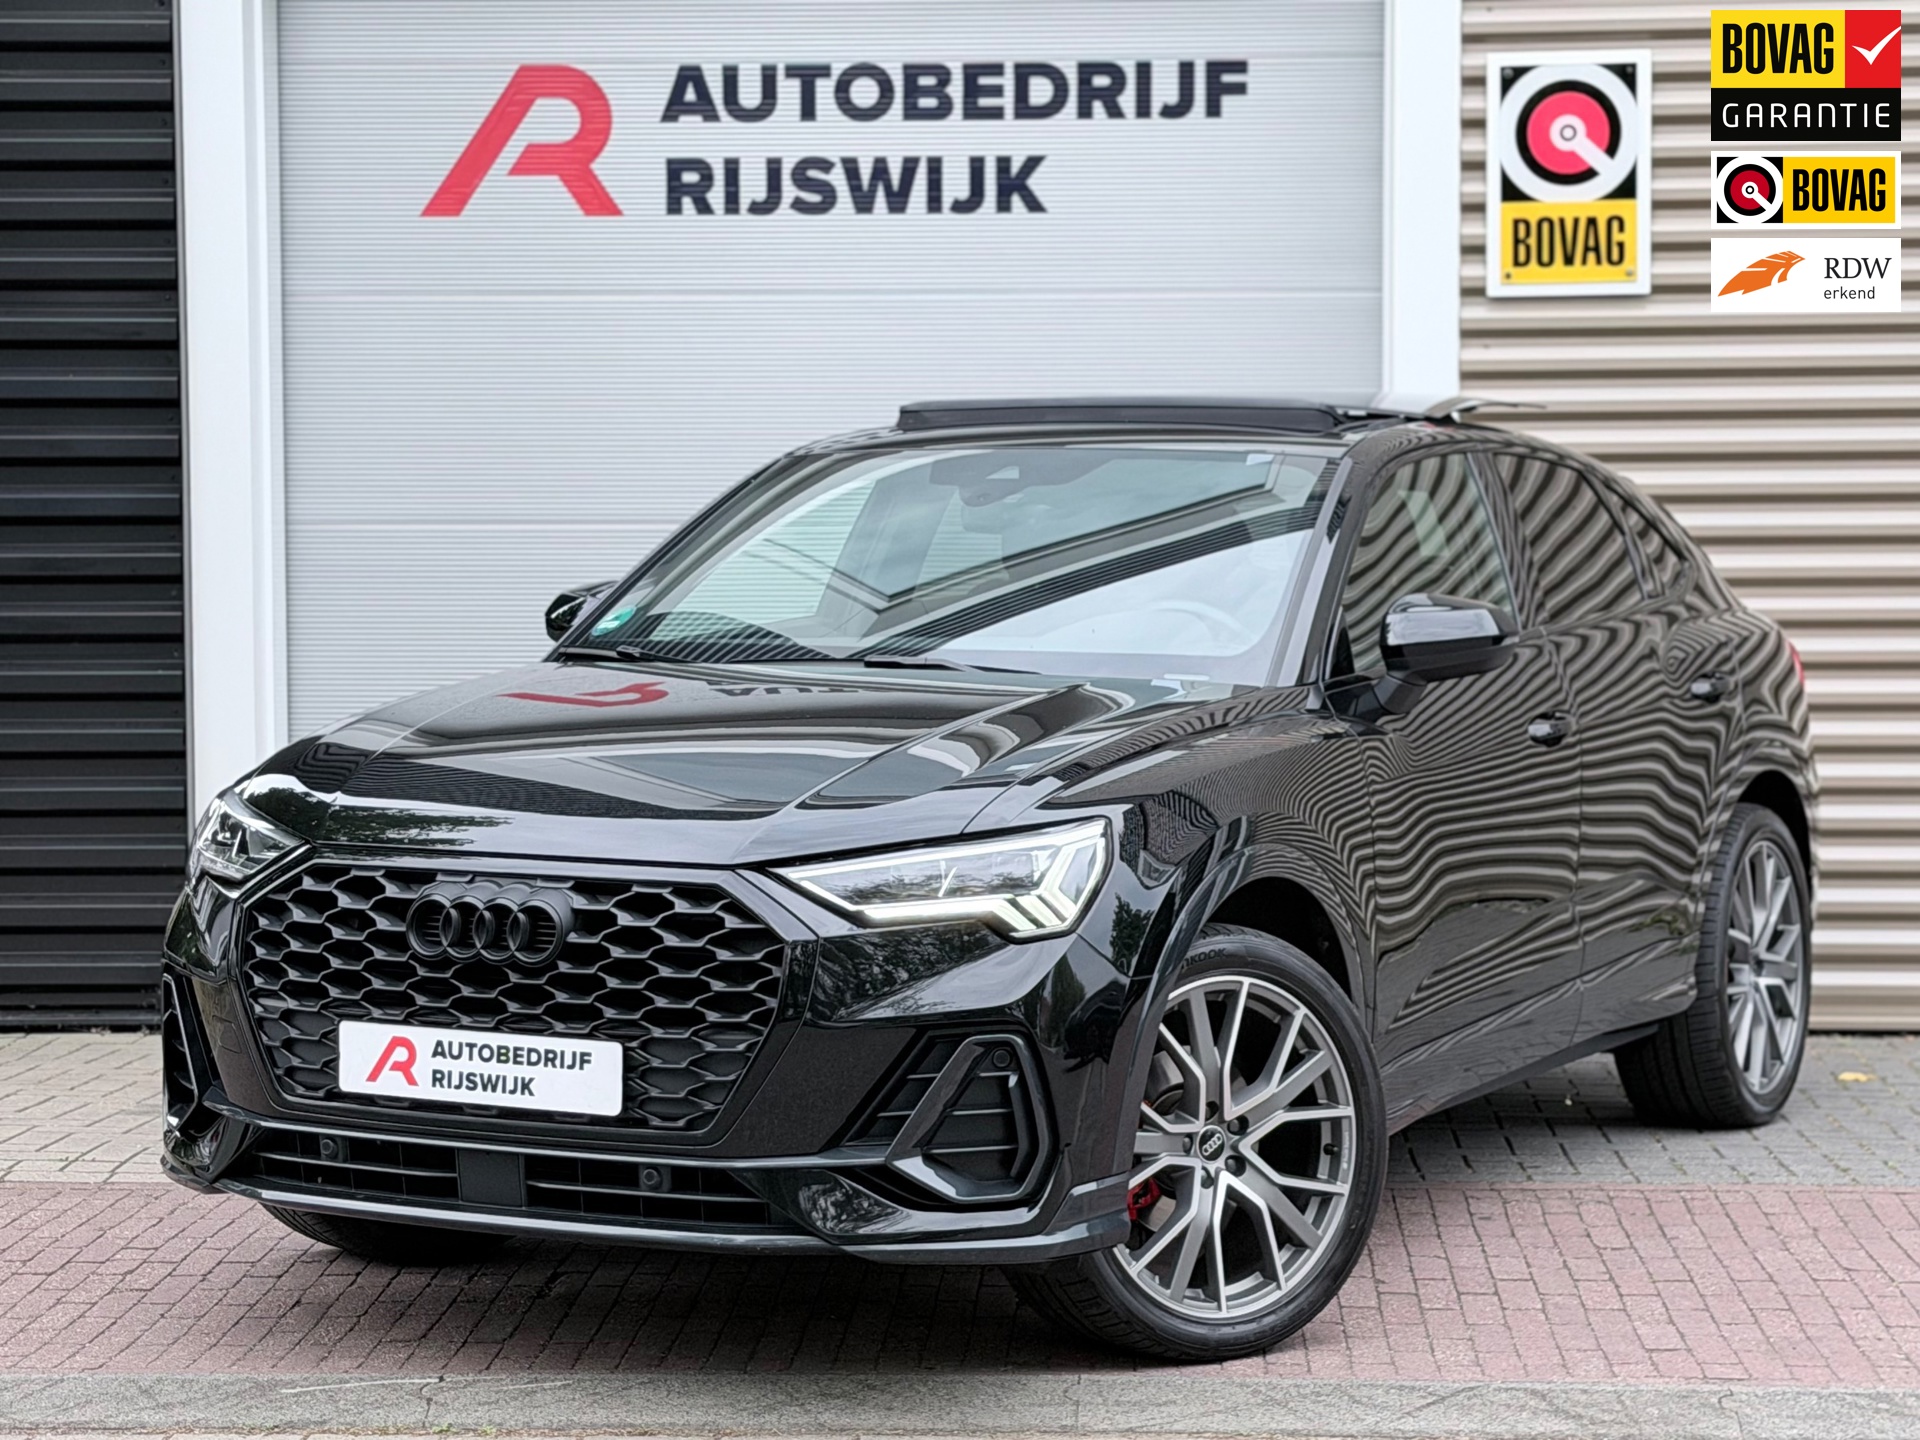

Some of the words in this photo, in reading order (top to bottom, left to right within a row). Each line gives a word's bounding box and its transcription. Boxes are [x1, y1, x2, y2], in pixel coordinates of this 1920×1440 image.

[660, 60, 1249, 123] AUTOBEDRIJF
[665, 155, 1048, 216] RIJSWIJK
[1512, 214, 1626, 268] BOVAG
[1181, 948, 1227, 969] NKOOK
[431, 1039, 593, 1070] AUTOBEDRIJF
[431, 1069, 535, 1096] RIJSWIJK
